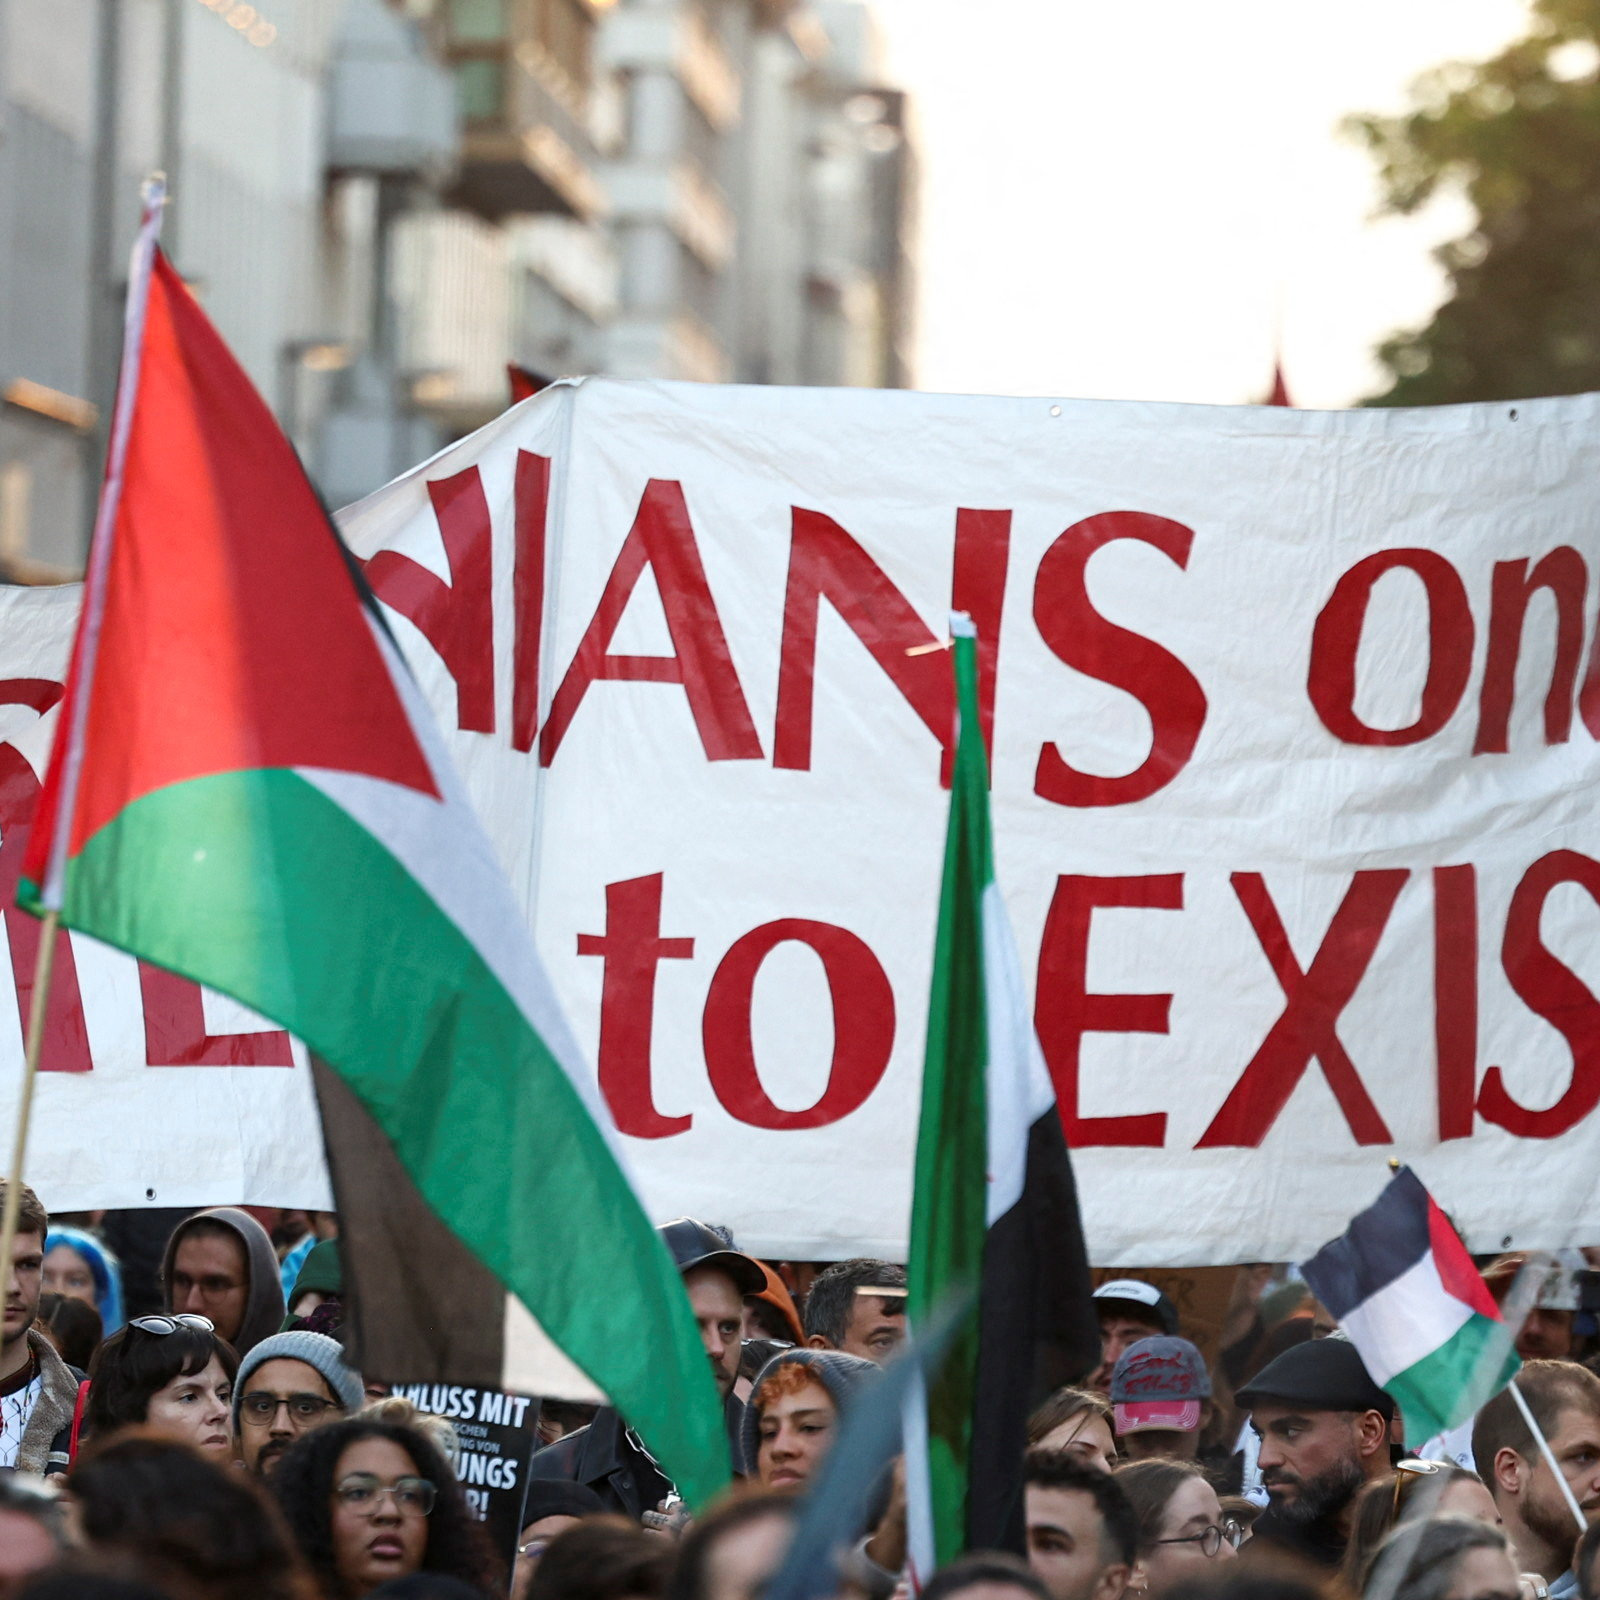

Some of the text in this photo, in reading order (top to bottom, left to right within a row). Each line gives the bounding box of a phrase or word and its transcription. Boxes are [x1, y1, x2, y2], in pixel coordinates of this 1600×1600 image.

[576, 870, 897, 1140] to
[478, 1391, 531, 1428] MIT
[476, 1440, 500, 1454] VON
